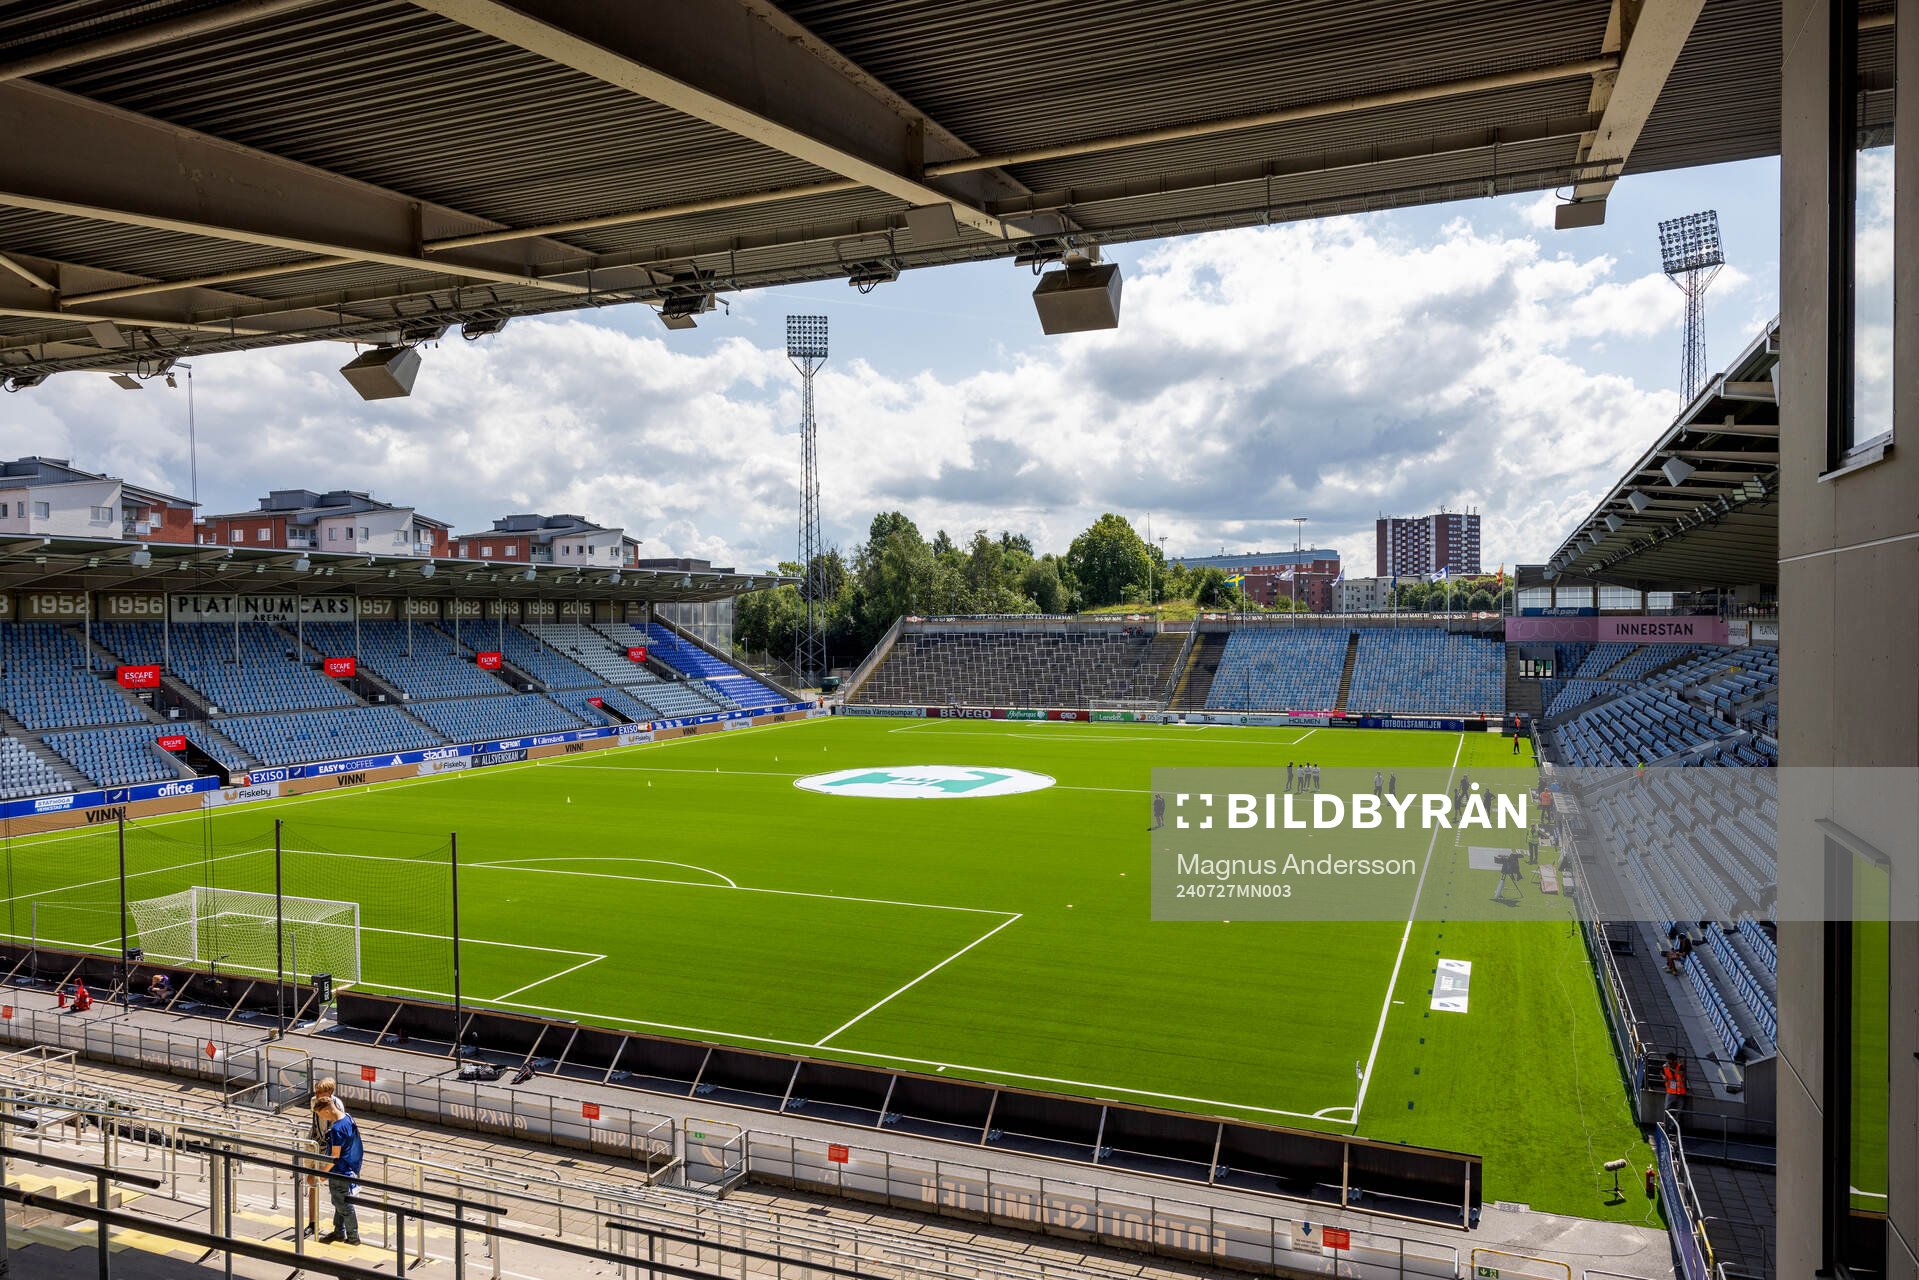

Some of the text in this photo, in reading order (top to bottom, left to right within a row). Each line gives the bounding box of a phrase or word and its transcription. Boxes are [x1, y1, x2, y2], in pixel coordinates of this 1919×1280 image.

[29, 595, 90, 614] 1952
[108, 596, 164, 614] 1956
[358, 600, 392, 614] 1957
[404, 600, 439, 615] 1960
[448, 600, 480, 615] 1962
[489, 601, 519, 615] 1963
[562, 601, 591, 615] 2015
[253, 613, 287, 622] ARENA
[1616, 623, 1694, 636] INNERSTAN
[124, 672, 153, 680] ESCAPE
[872, 708, 913, 717] Värmepumpar
[940, 709, 992, 718] BEVEGO
[618, 724, 638, 734] EXISO
[1382, 719, 1442, 729] FOTBOLLSFAMILJEN
[423, 747, 459, 761] stadium
[565, 743, 584, 753] VINN!
[482, 750, 519, 765] ALLSVENSKAN
[318, 759, 374, 774] EASY COFFEE
[443, 760, 466, 769] Fiskeby
[252, 770, 284, 783] EXISO
[338, 773, 366, 786] VINN!
[158, 782, 193, 797] office
[238, 788, 272, 799] Fiskeby
[86, 806, 126, 823] VINN!
